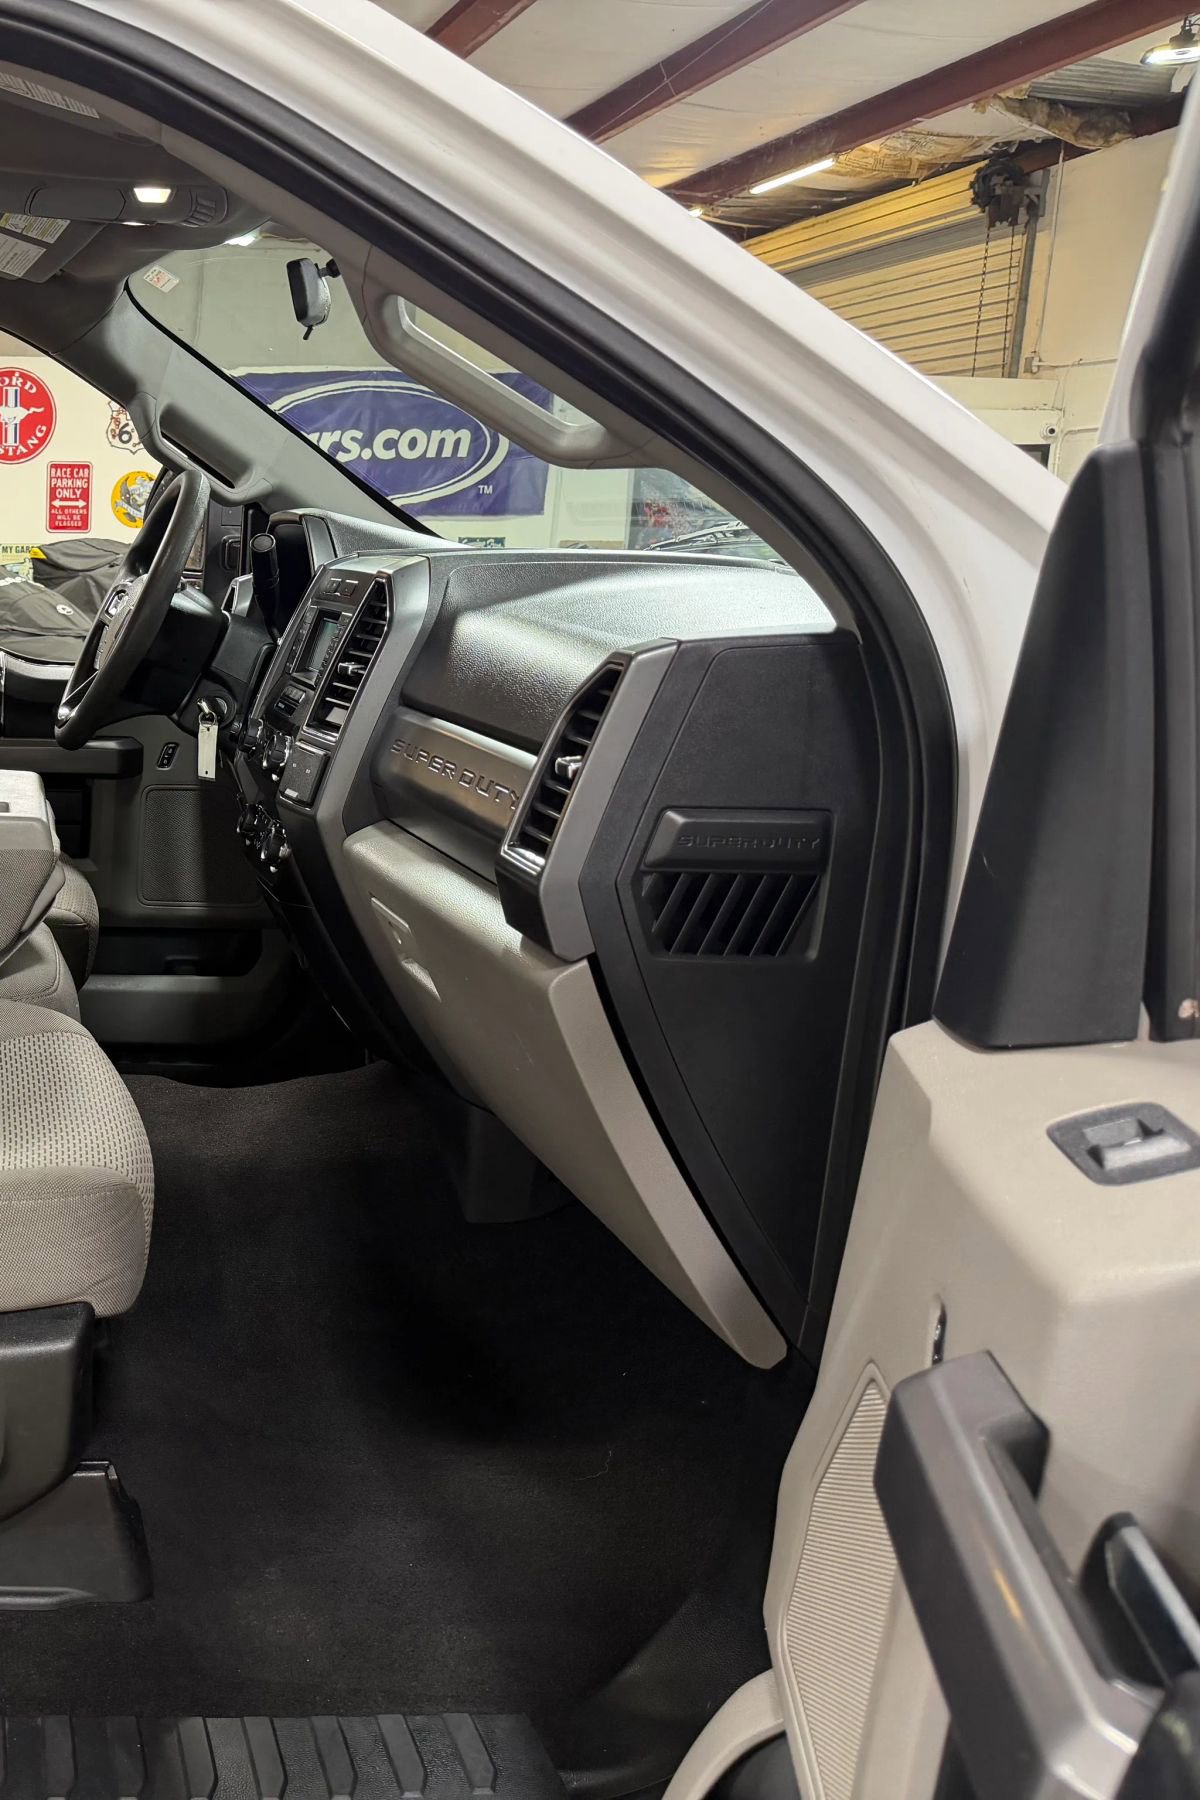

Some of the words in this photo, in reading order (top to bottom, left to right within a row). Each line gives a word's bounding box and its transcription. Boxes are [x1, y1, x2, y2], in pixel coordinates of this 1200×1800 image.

[305, 428, 472, 463] rs.com
[50, 468, 71, 478] RACE
[73, 468, 89, 478] CAR
[51, 478, 88, 489] PARKING
[55, 488, 82, 498] ONLY
[1, 545, 13, 554] MY
[15, 545, 31, 554] GAR
[391, 738, 457, 780] SUPER
